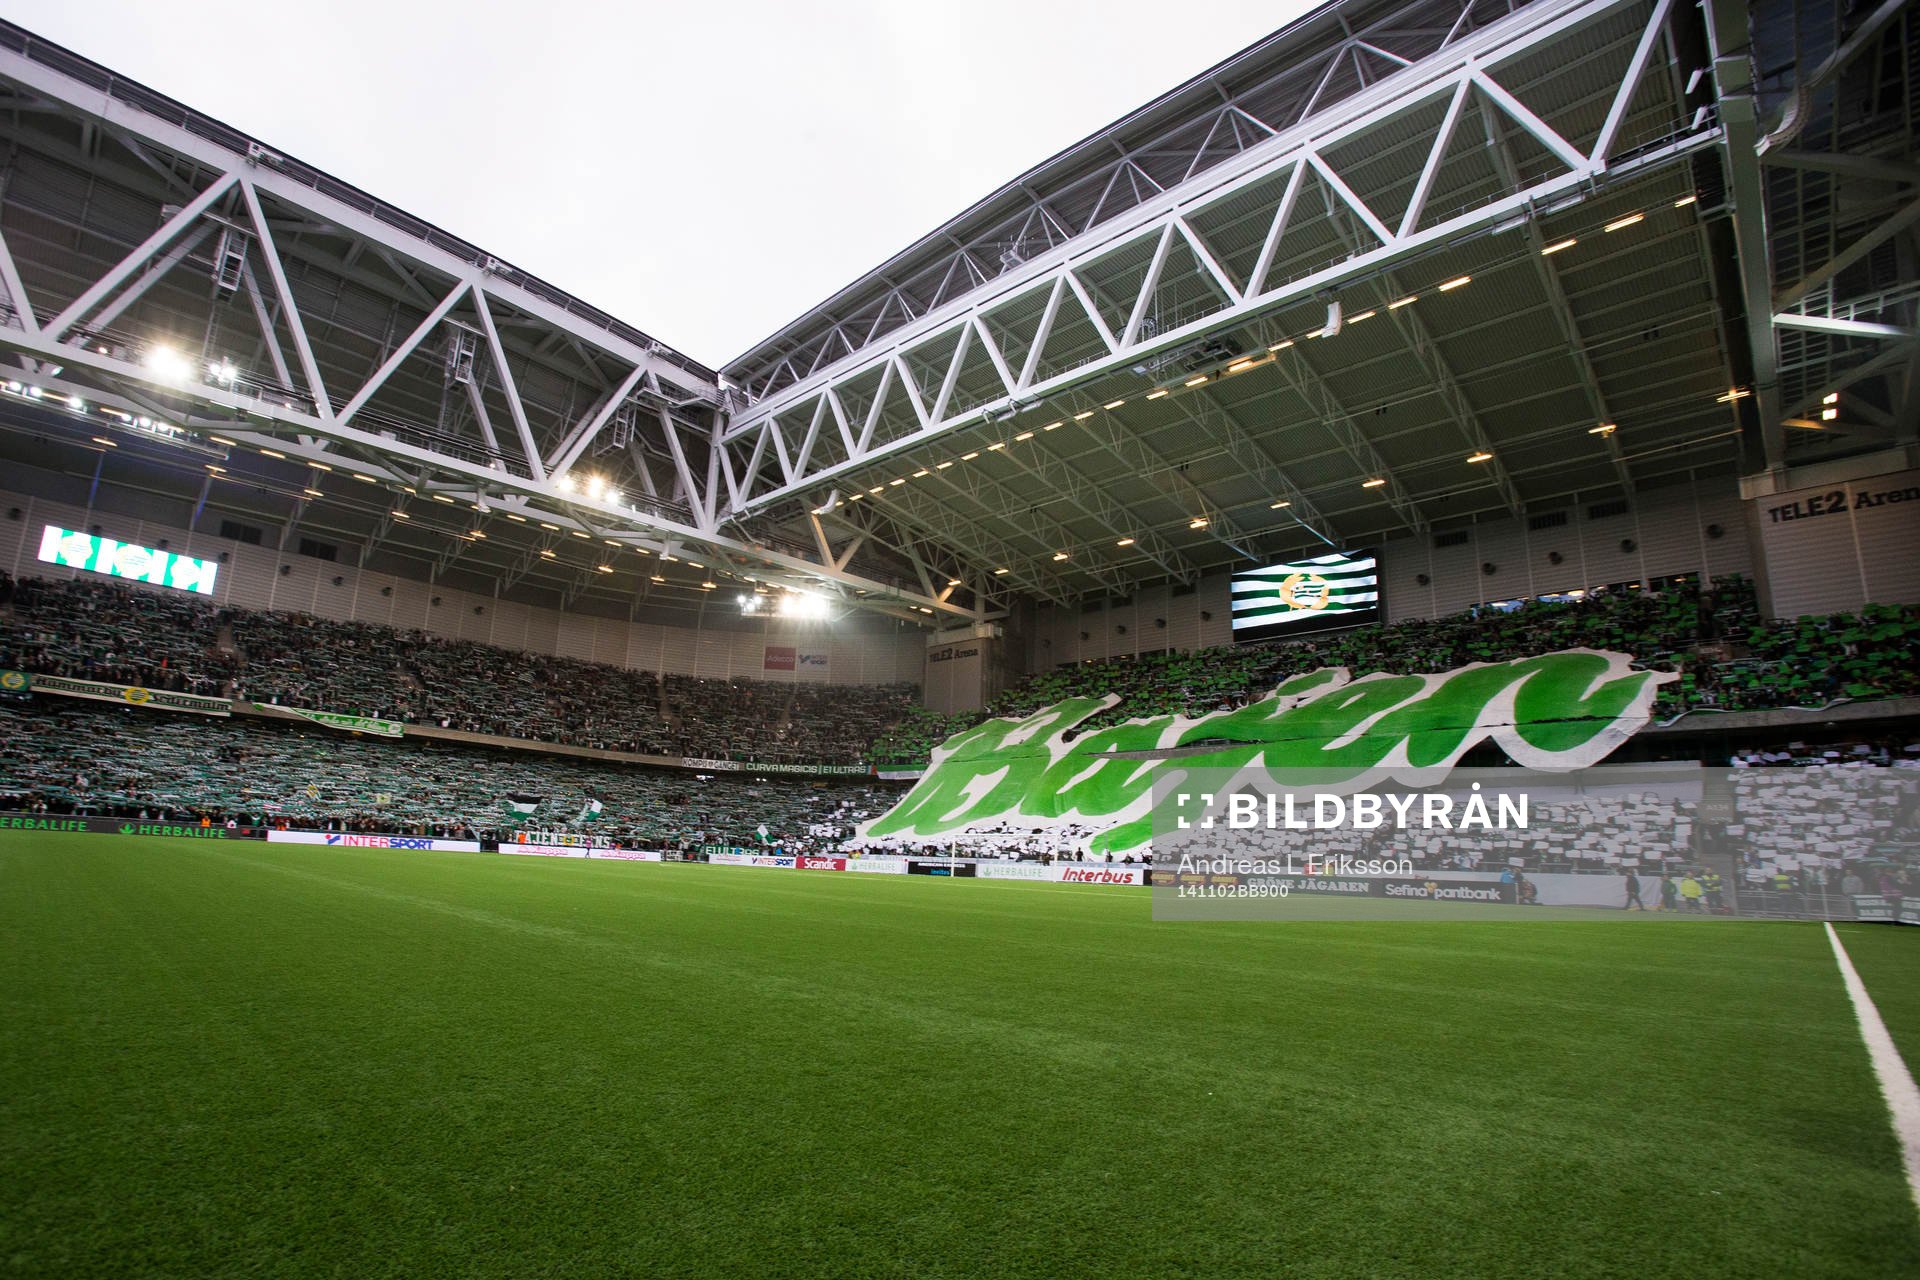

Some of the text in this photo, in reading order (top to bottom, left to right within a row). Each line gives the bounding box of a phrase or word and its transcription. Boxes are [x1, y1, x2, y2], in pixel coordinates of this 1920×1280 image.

[1768, 486, 1920, 523] TELE2 Aren
[746, 762, 778, 772] CURVA
[139, 824, 226, 839] HERBALIFE
[344, 835, 434, 850] INTERSPORT
[757, 858, 795, 867] INTERSPORT
[804, 859, 837, 870] Scandic
[860, 862, 896, 871] HERBALIFE
[993, 866, 1043, 877] HERBALIFE
[1062, 867, 1134, 884] Interbus
[1298, 877, 1370, 893] JÄGAREN
[1385, 883, 1501, 900] Sefina pantbank
